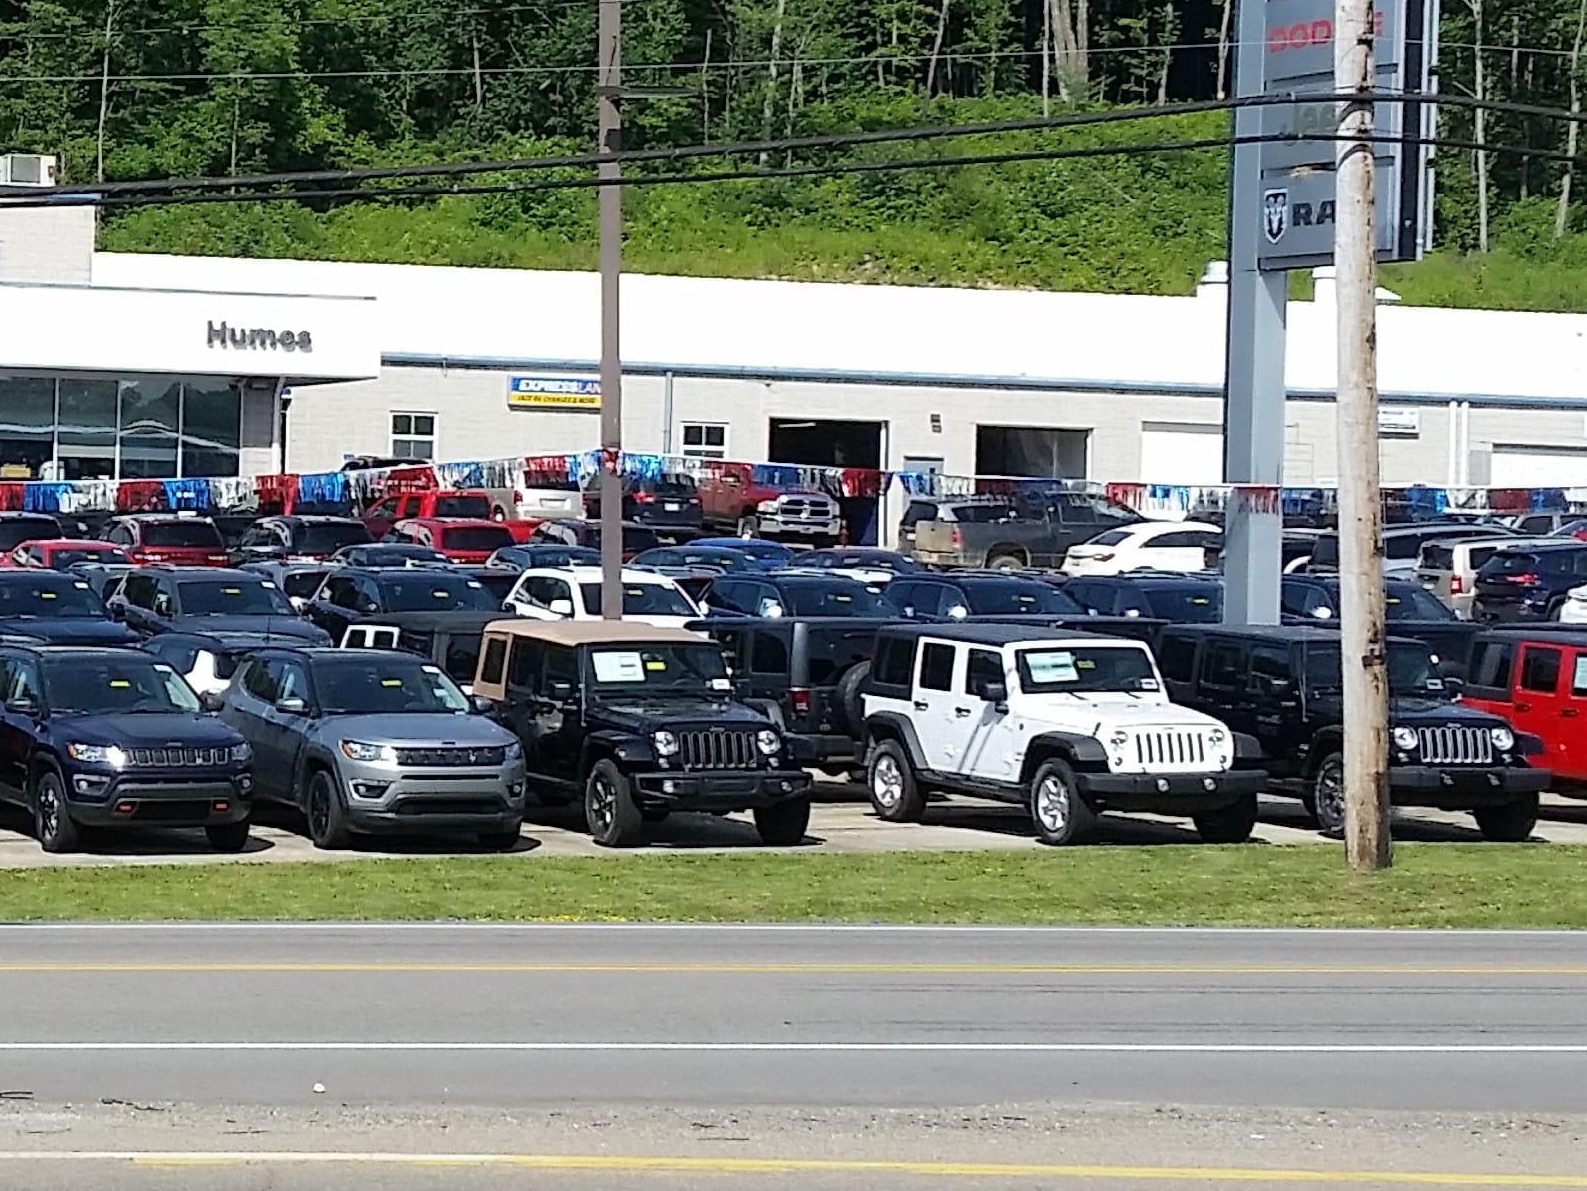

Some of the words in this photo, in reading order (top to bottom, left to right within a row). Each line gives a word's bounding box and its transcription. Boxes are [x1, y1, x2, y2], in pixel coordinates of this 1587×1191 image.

[1268, 11, 1385, 52] DODE
[1292, 200, 1335, 226] RA
[207, 320, 312, 352] Humes
